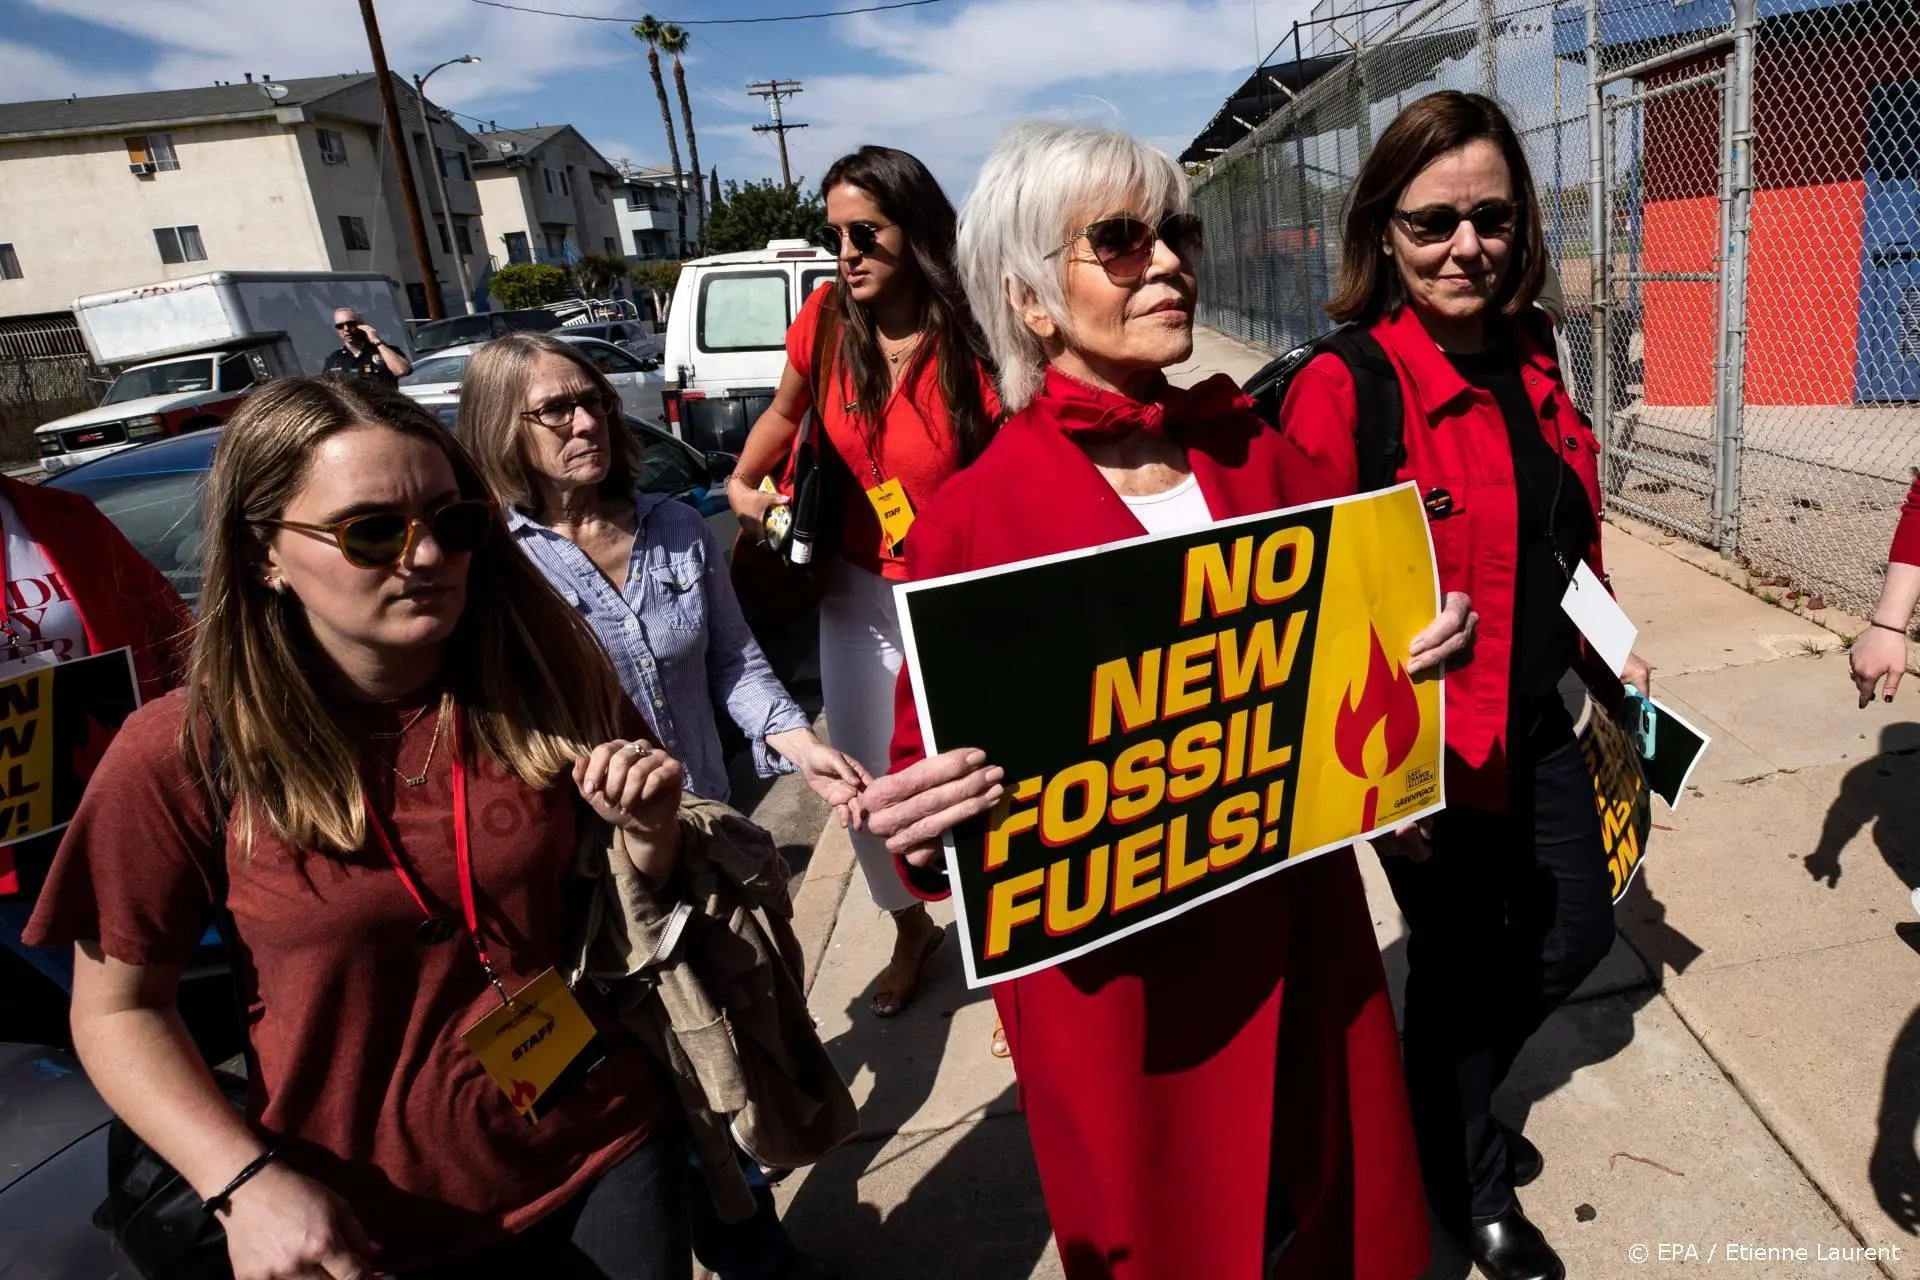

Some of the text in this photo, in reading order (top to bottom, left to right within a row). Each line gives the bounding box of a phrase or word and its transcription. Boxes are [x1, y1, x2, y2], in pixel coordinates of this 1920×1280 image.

[884, 506, 901, 519] STAFF
[1179, 525, 1315, 627] NO
[1088, 609, 1309, 745] NEW
[983, 701, 1292, 872] FOSSIL
[1394, 785, 1435, 808] GREENPEACE
[983, 779, 1284, 960] FUELS!
[511, 1020, 556, 1062] STAFF
